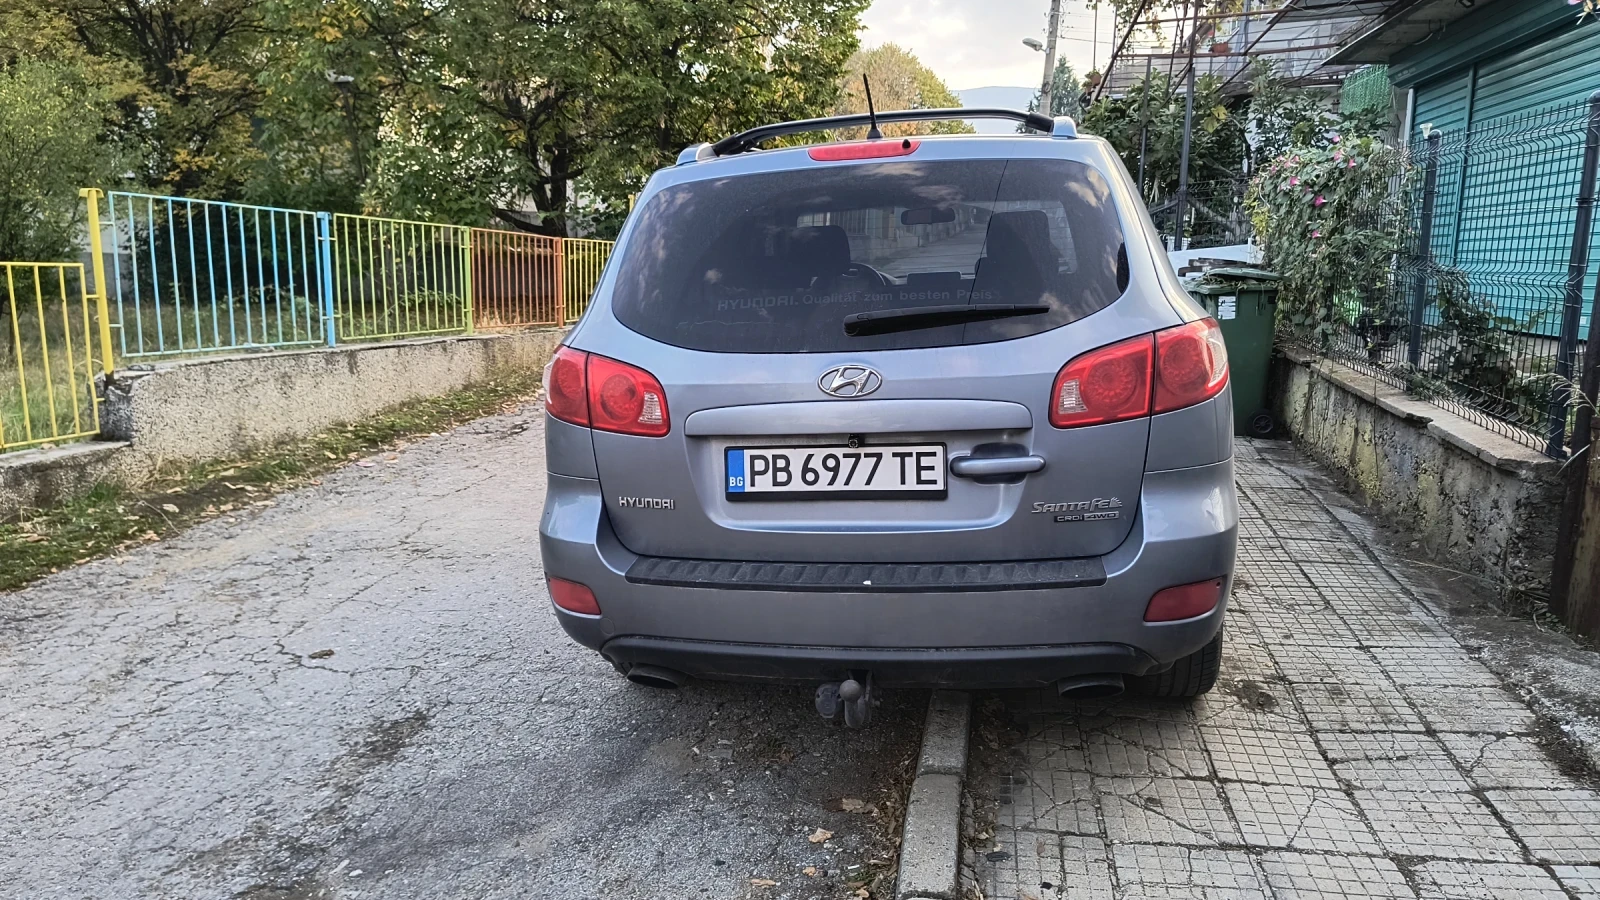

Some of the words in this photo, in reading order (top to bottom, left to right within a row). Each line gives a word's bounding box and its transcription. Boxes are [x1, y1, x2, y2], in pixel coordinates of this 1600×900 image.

[864, 292, 893, 302] zum
[900, 290, 950, 300] besten
[750, 454, 793, 487] PB
[801, 452, 883, 486] 6977
[892, 452, 938, 485] TE
[729, 476, 744, 487] BG
[619, 496, 674, 510] HYUNDAI
